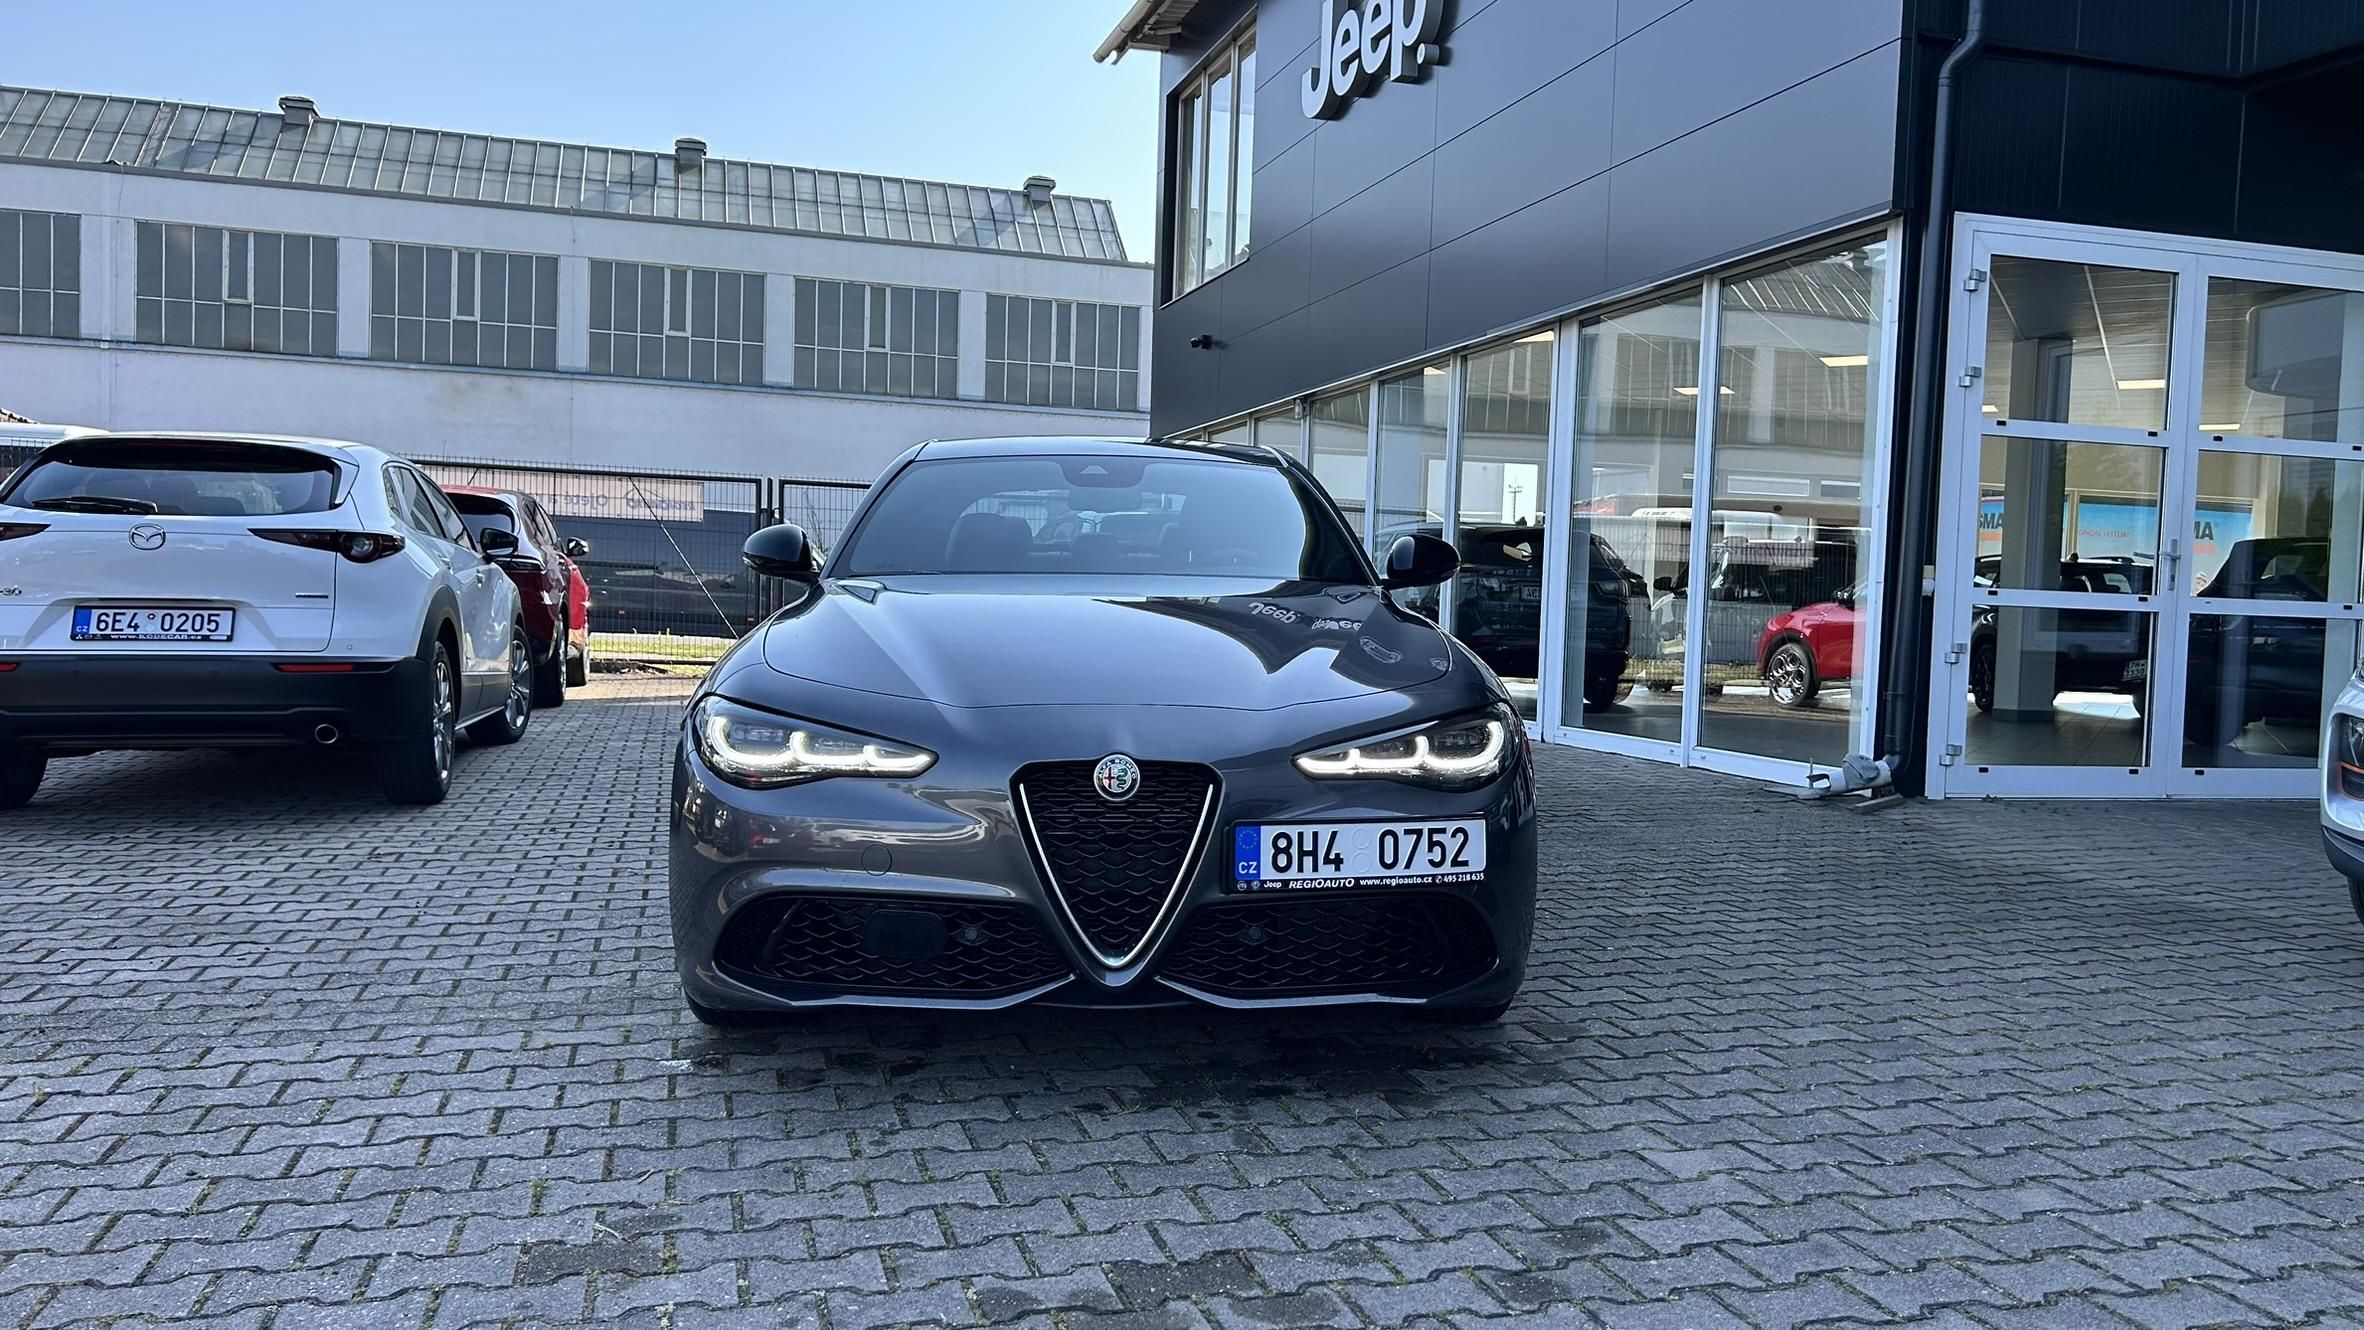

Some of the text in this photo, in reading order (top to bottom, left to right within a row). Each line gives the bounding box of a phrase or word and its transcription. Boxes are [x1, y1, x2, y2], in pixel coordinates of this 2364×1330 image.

[95, 612, 221, 633] 6E4 0205
[1271, 826, 1469, 874] 8H4 0752
[1238, 861, 1258, 874] CZ
[1263, 873, 1485, 889] Jeep REGIOAUTO www.regioauto.cz 495 218 635
